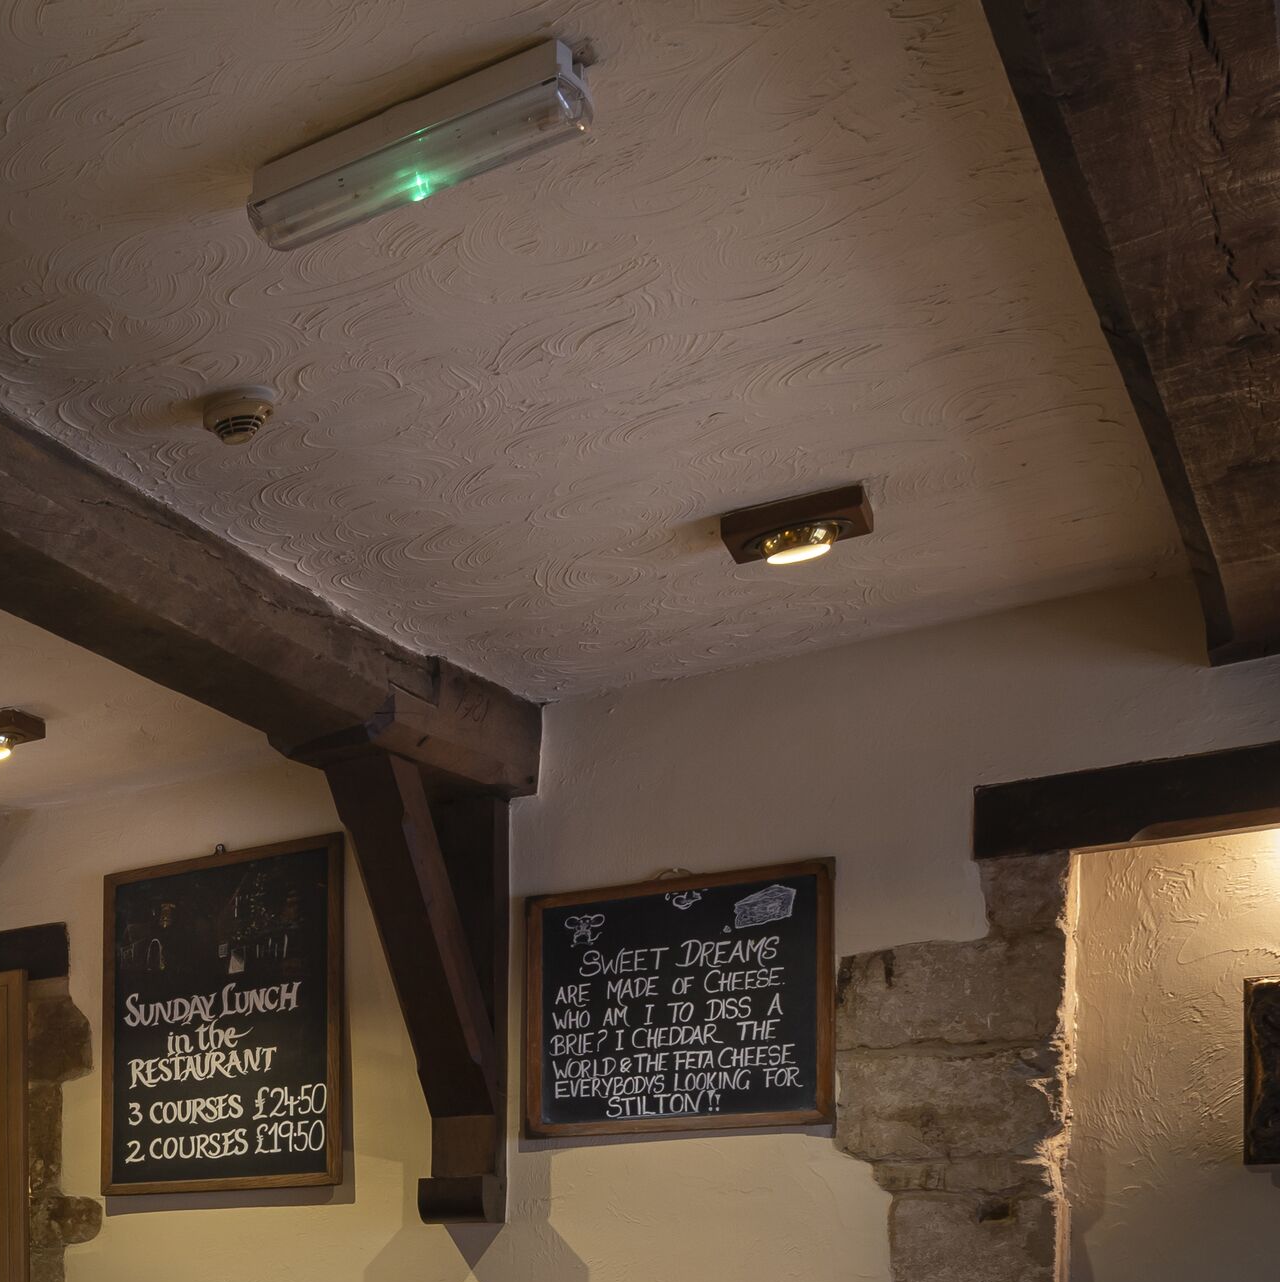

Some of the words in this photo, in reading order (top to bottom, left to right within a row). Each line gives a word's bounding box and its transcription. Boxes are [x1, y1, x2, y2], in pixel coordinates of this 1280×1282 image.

[579, 947, 669, 977] SWEET
[675, 936, 780, 968] DREAMS
[124, 993, 218, 1027] SUNDAY
[219, 981, 302, 1019] LUNCH
[555, 983, 591, 1007] ARE
[607, 976, 659, 1006] MADE
[672, 976, 695, 995] OF
[552, 1009, 590, 1030] WHO
[603, 1006, 630, 1027] AM
[645, 1005, 653, 1024] I
[667, 1002, 694, 1023] TO
[704, 997, 752, 1021] DISS
[767, 993, 784, 1016] A
[167, 1031, 193, 1056] in
[195, 1020, 254, 1050] the
[550, 1030, 608, 1058] BRIE?
[616, 1031, 624, 1051] I
[631, 1024, 724, 1049] CHEDDAR
[737, 1019, 781, 1042] THE
[127, 1047, 277, 1089] RESTAURANT
[552, 1057, 616, 1080] WORLD
[620, 1057, 632, 1073] &
[634, 1054, 668, 1073] THE
[674, 1050, 715, 1071] FETA
[717, 1044, 797, 1068] CHEESE
[554, 1076, 665, 1099] EVERYBODYS
[673, 1069, 750, 1092] LOOKING
[764, 1067, 803, 1088] FOR
[128, 1102, 143, 1126] 3
[149, 1095, 244, 1124] COURSES
[125, 1140, 145, 1164] 2
[149, 1129, 248, 1159] COURSES
